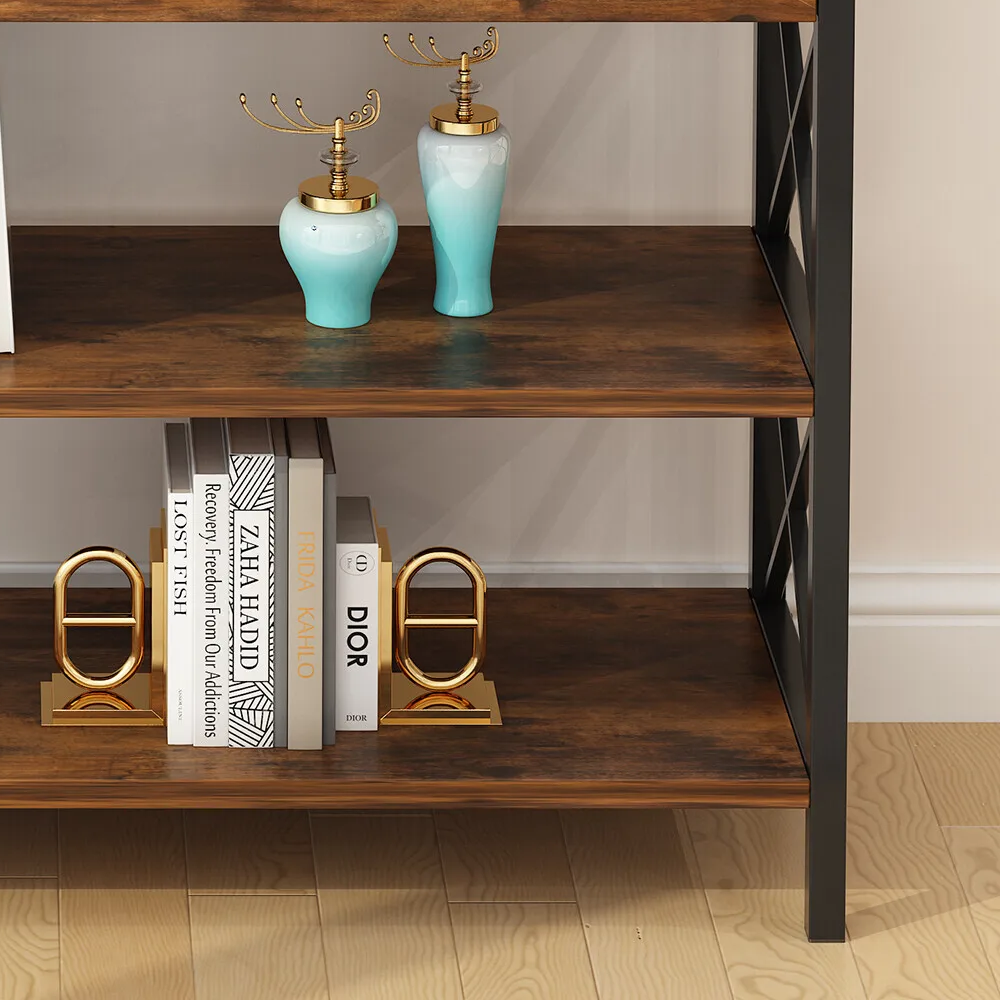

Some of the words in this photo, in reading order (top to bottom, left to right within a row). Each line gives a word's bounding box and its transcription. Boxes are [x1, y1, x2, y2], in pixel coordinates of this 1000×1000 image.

[174, 501, 187, 558] LOST
[199, 484, 221, 544] Recovery.
[205, 549, 222, 603] Freedom
[240, 525, 259, 588] ZAHA
[297, 531, 315, 592] FRIDA
[174, 567, 187, 615] FISH
[205, 608, 221, 639] From
[240, 594, 259, 670] HADID
[297, 607, 315, 679] KAHLO
[347, 607, 368, 667] DIOR
[205, 644, 221, 668] Our
[205, 671, 222, 737] Addictions
[345, 715, 367, 723] DIOR
